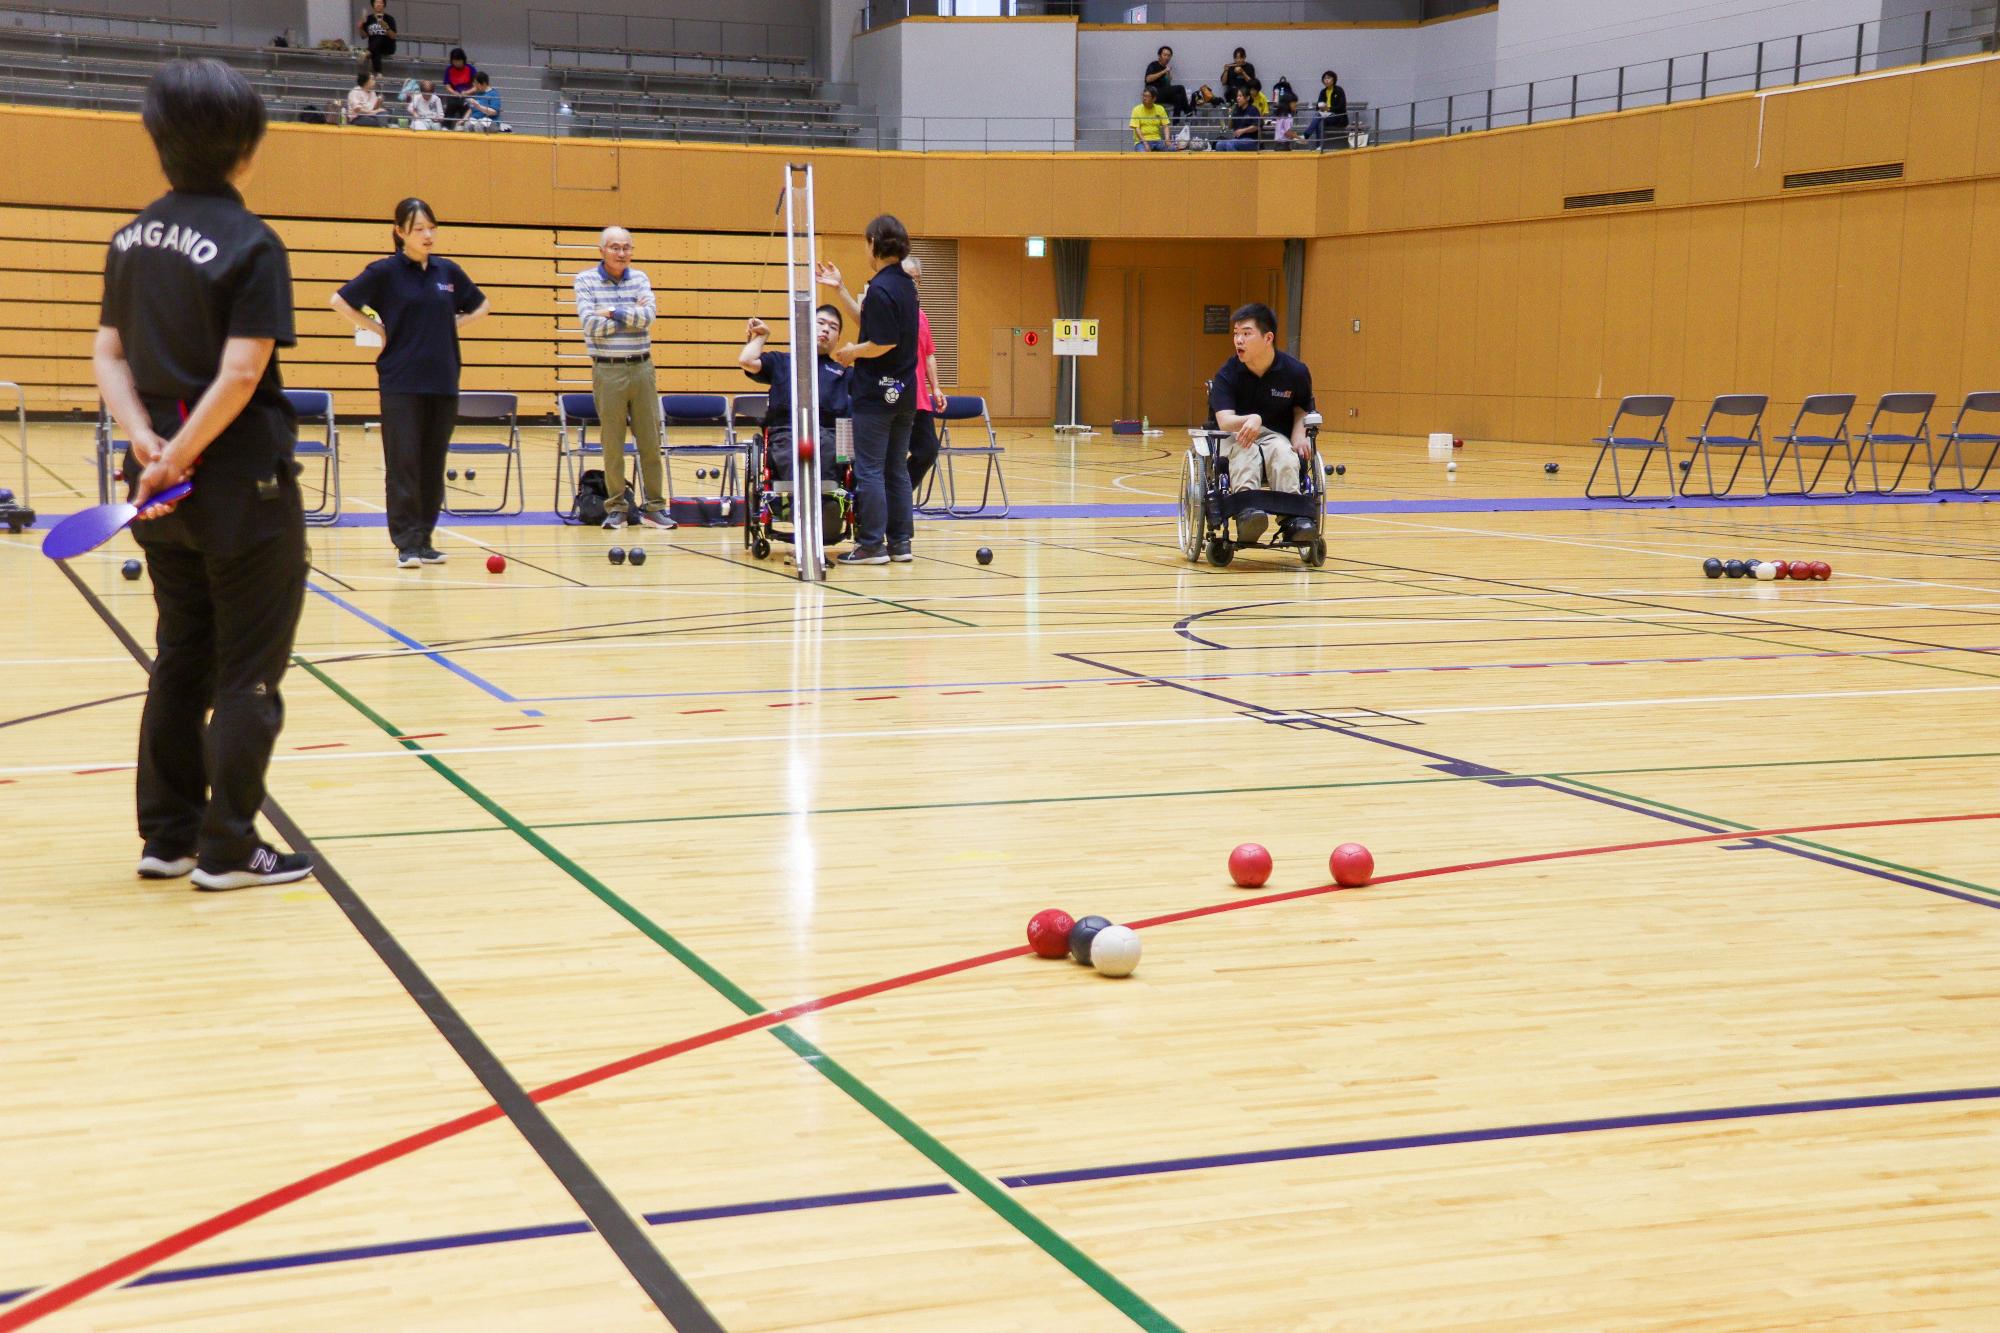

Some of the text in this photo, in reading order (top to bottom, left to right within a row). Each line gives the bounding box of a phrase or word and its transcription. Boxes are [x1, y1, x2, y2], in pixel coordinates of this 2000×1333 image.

[114, 220, 218, 265] NAGANO
[1064, 325, 1071, 336] 0
[1090, 325, 1096, 336] 0
[250, 848, 278, 872] N
